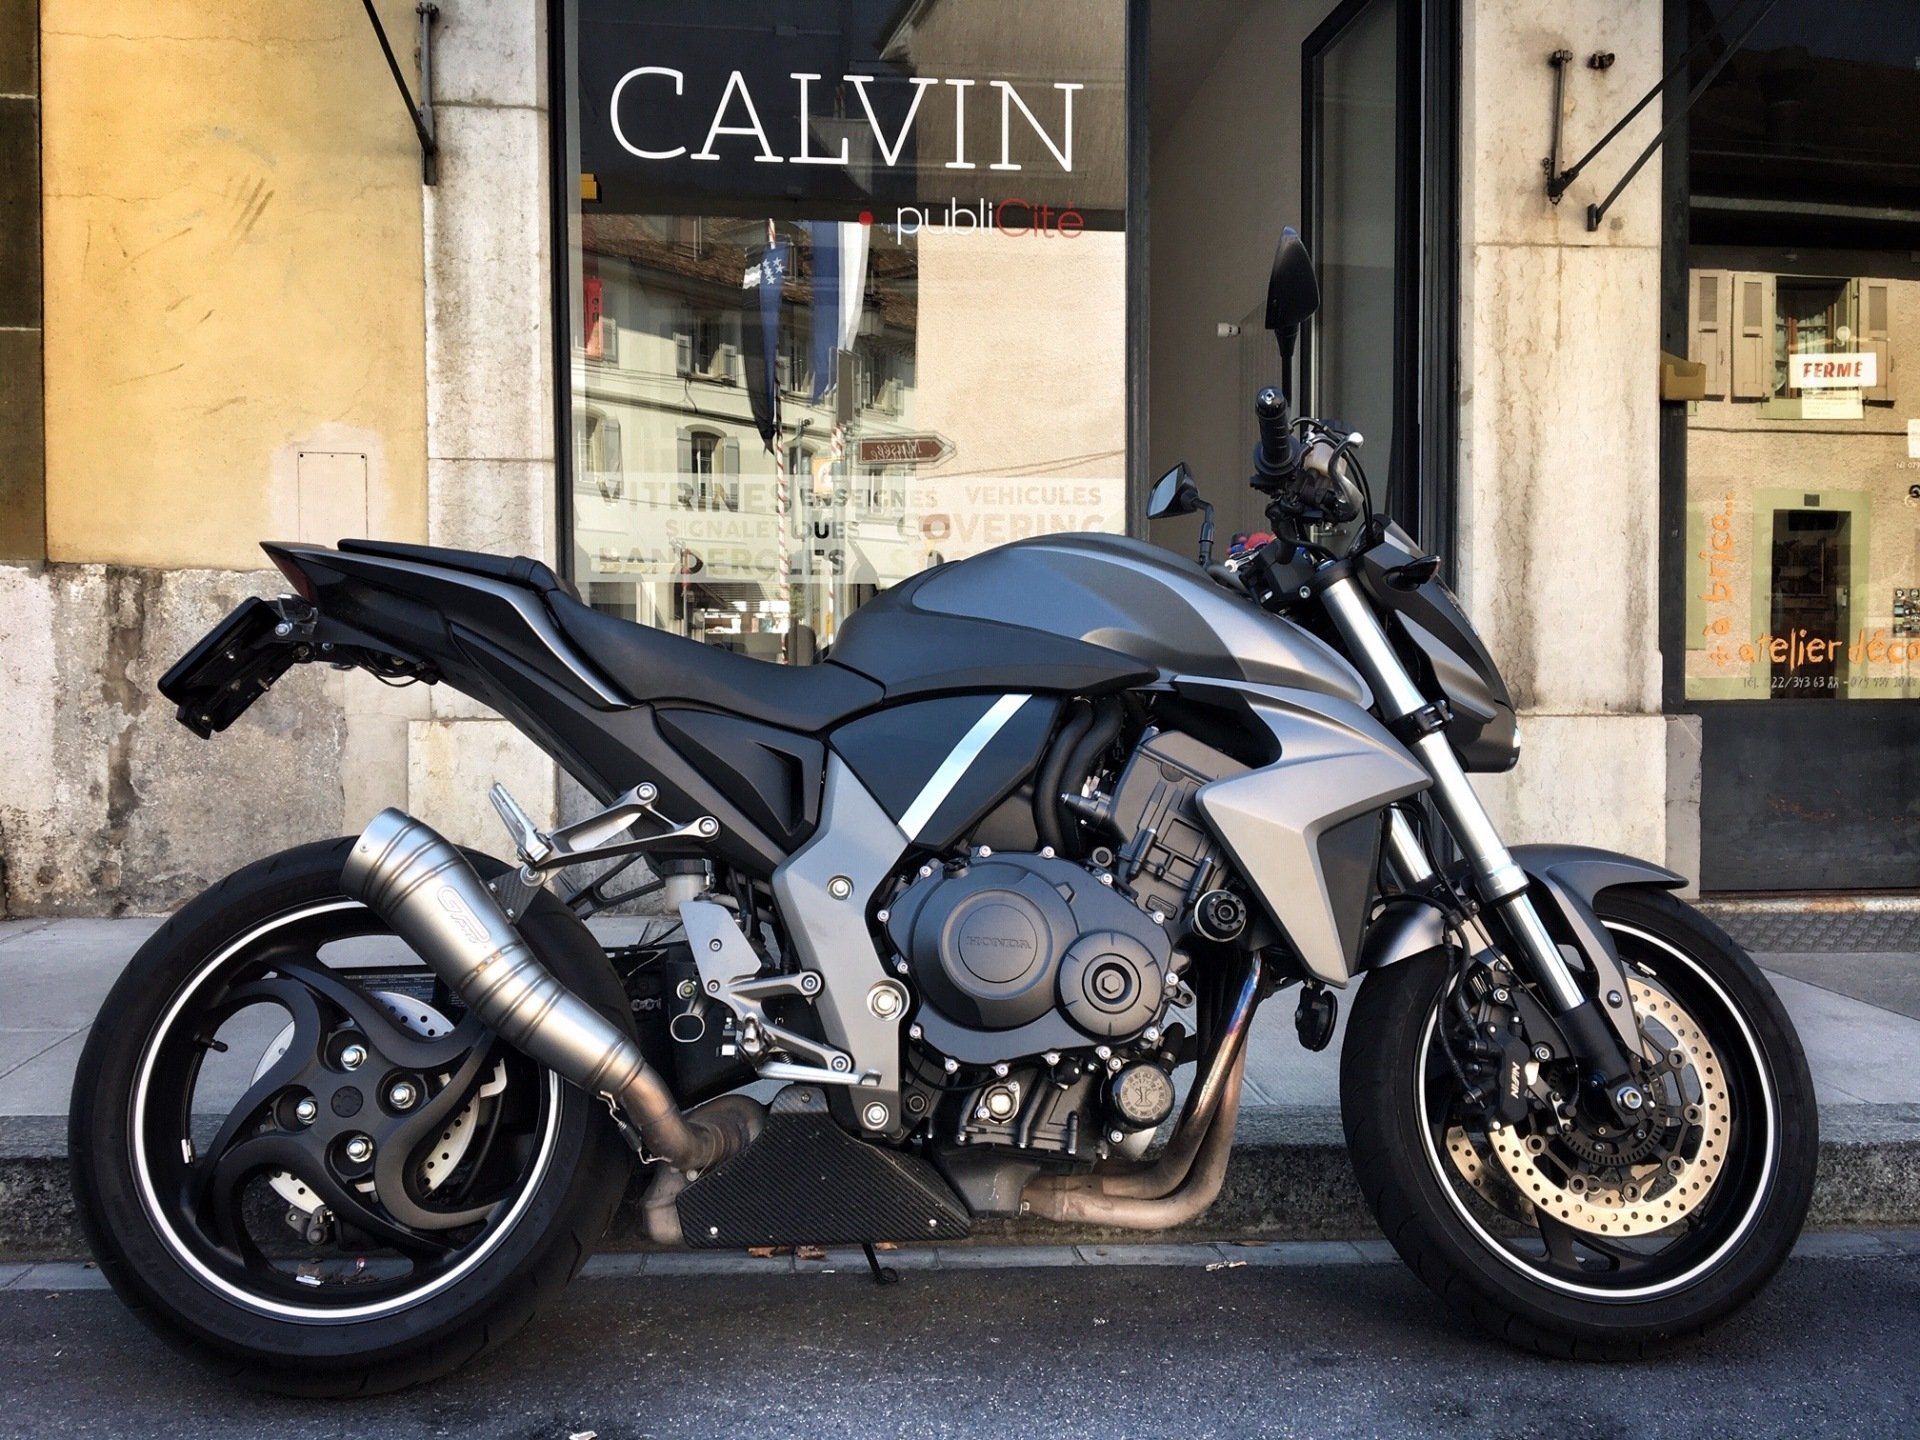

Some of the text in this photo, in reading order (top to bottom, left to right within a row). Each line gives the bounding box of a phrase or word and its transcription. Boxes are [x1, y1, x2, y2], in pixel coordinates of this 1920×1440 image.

[609, 65, 1085, 173] CALVIN
[896, 196, 1084, 246] publiCité
[598, 480, 1102, 514] VITRINES ENSEIGNES VEHICULES
[665, 518, 860, 541] SIGNALETQUES
[1738, 627, 1843, 674] atelier
[965, 935, 1033, 949] HONDA
